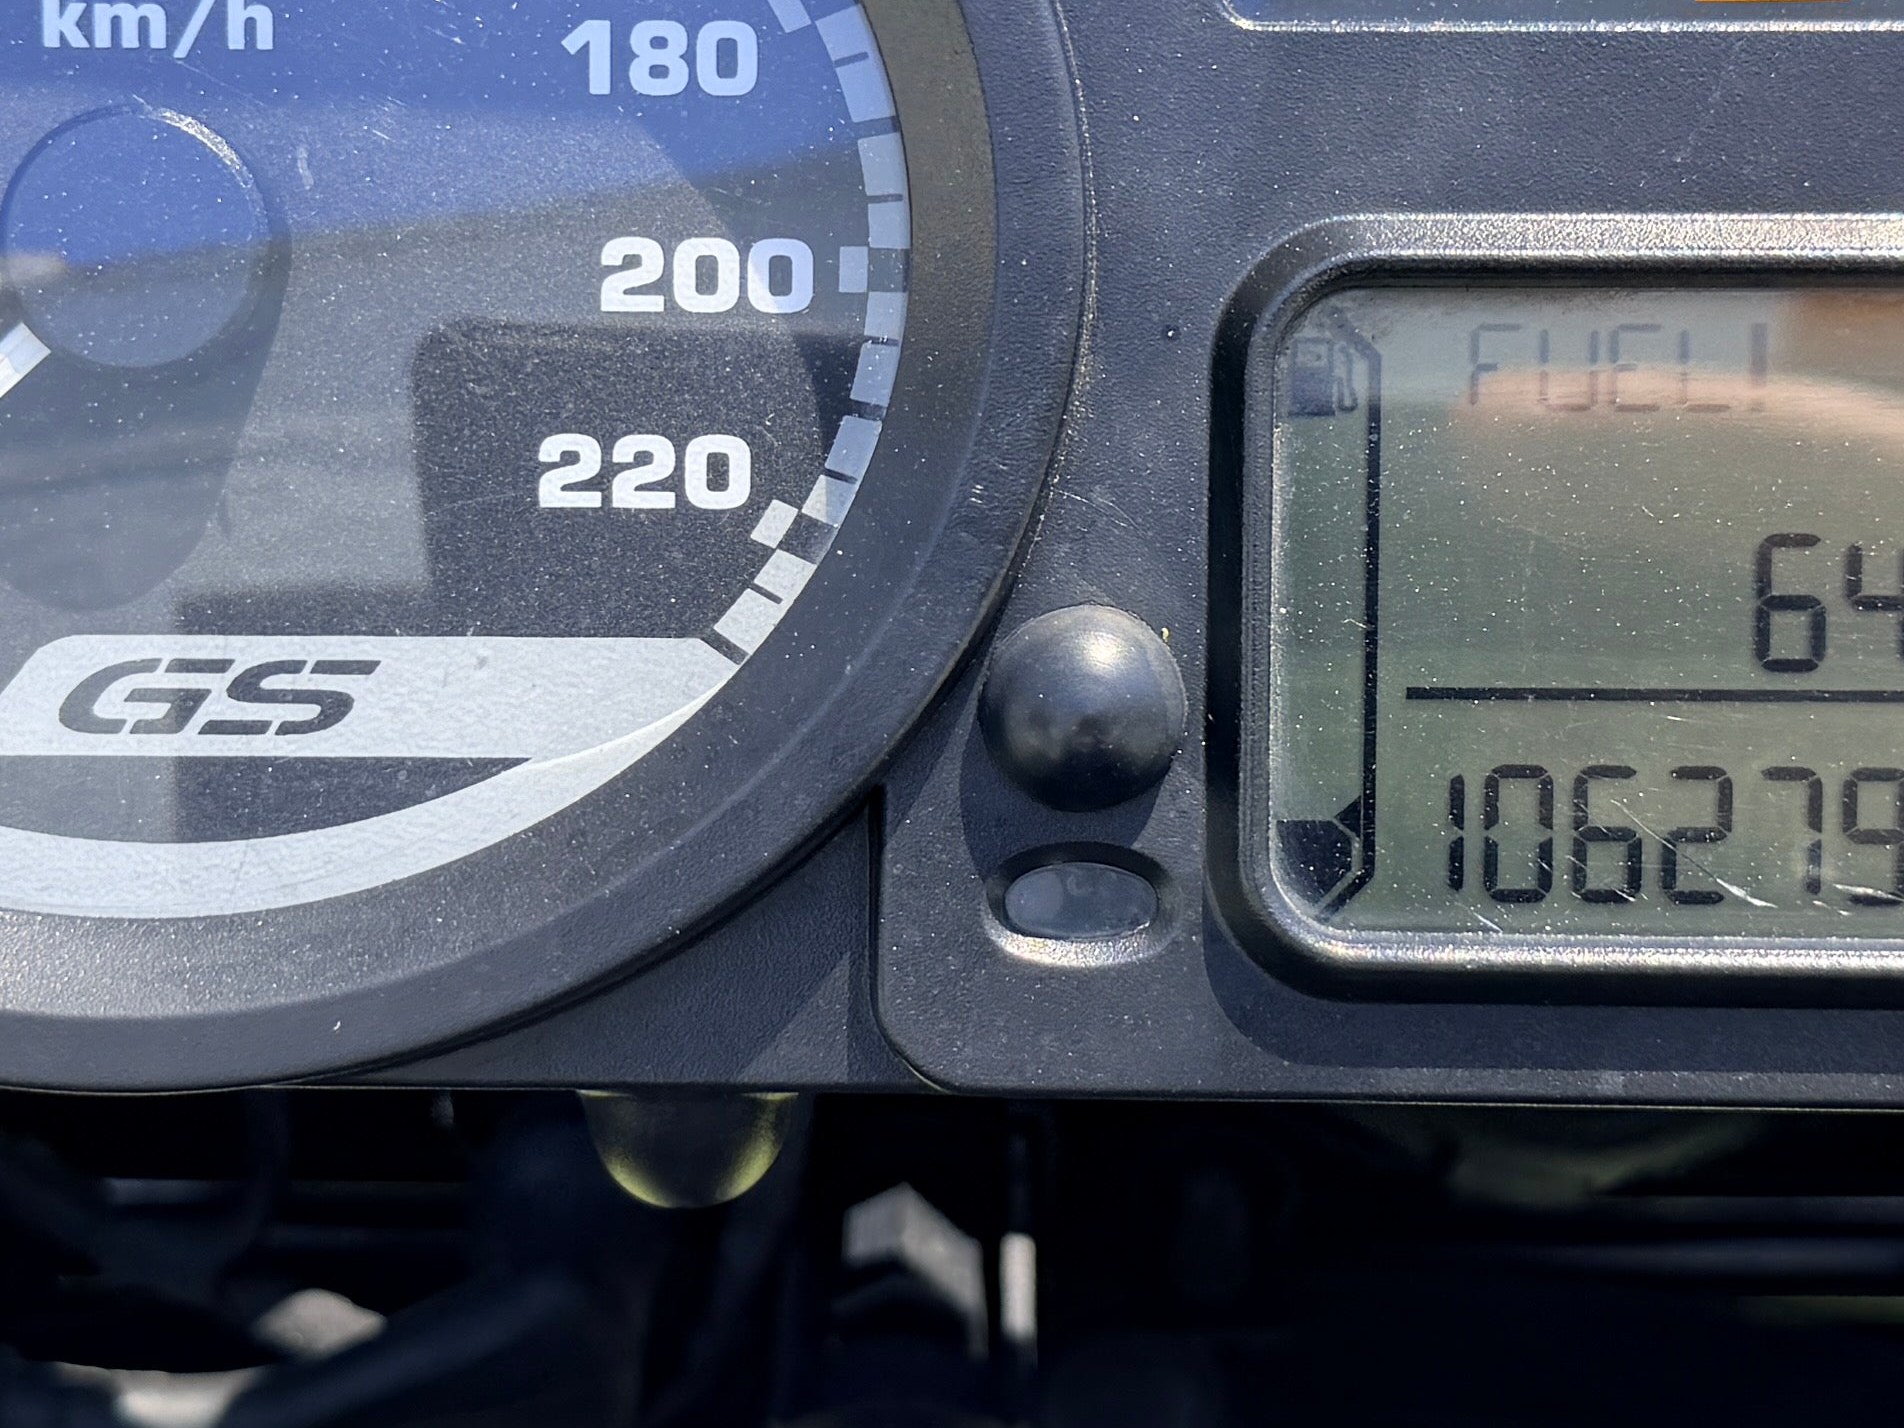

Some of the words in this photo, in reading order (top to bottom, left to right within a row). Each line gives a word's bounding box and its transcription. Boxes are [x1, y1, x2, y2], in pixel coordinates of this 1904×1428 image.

[560, 19, 758, 97] 180
[598, 236, 815, 314] 200
[537, 431, 752, 511] 220
[55, 656, 384, 738] GS
